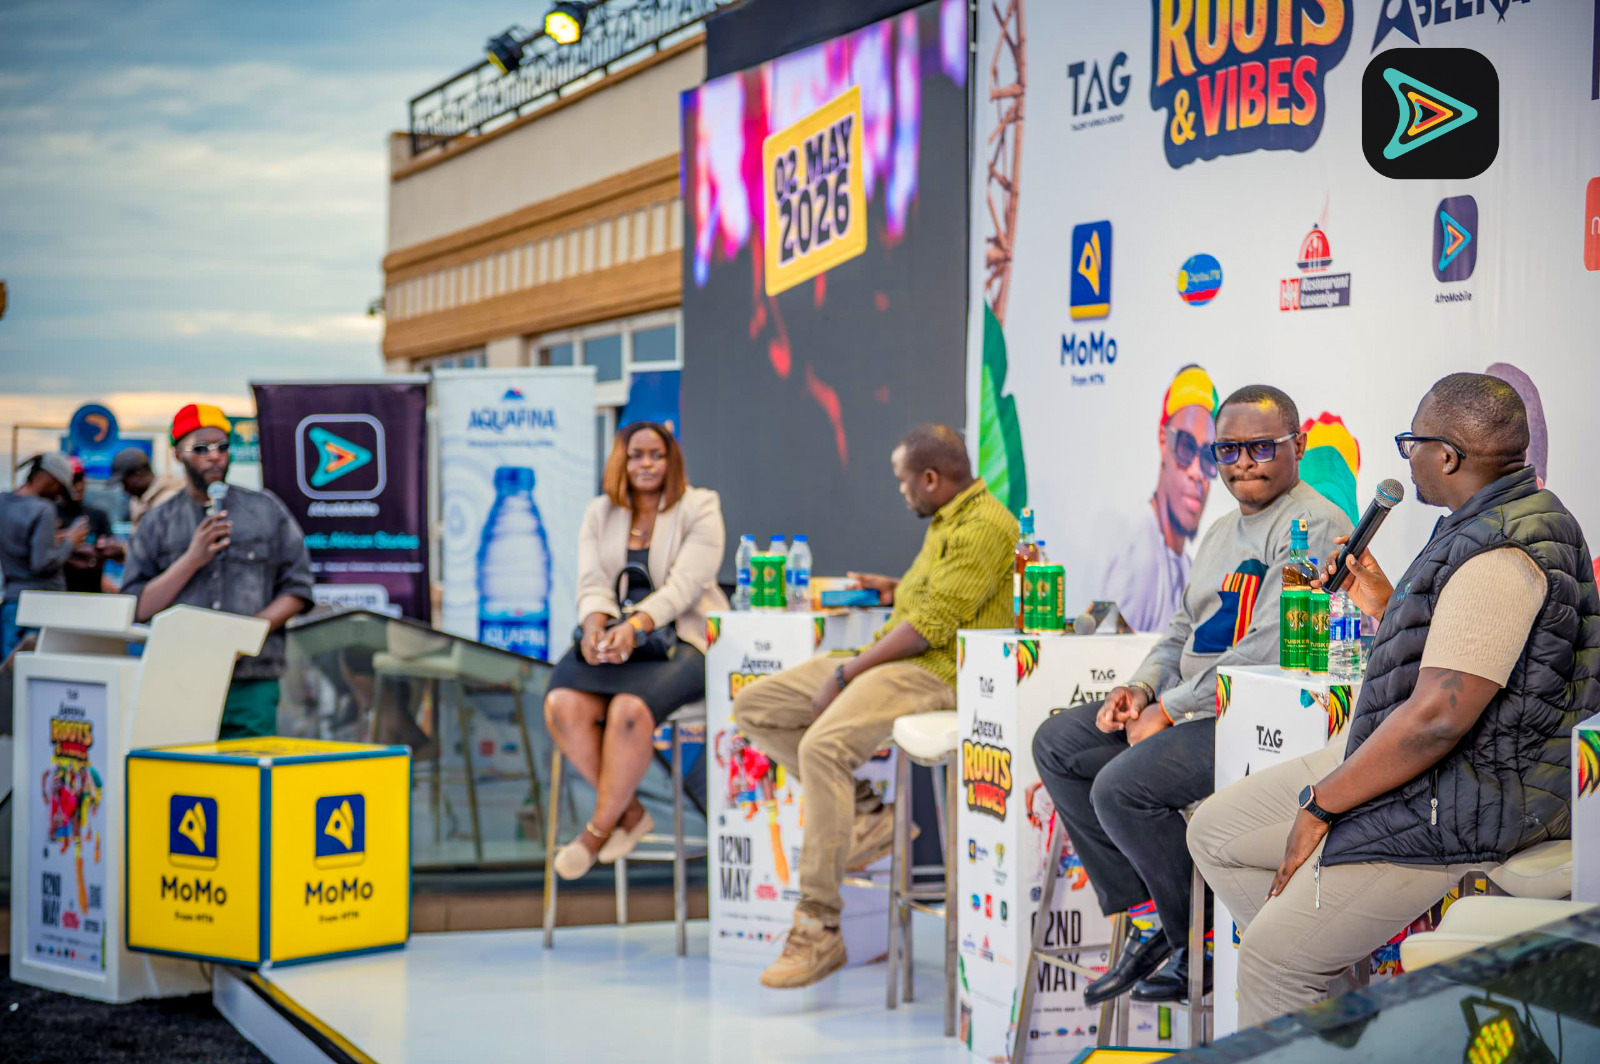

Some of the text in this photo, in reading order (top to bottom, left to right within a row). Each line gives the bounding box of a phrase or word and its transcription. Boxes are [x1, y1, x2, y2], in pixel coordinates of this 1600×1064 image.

[1067, 51, 1131, 116] TAG
[1170, 55, 1318, 145] & VIBES
[775, 115, 854, 200] 02 MAY
[780, 168, 850, 264] 2026
[1060, 331, 1118, 366] MoMo
[467, 408, 558, 434] AQUAFINA
[979, 676, 995, 694] TAG
[1090, 669, 1116, 680] TAG
[1256, 725, 1283, 748] TAG
[963, 741, 1011, 791] ROOTS
[975, 781, 1006, 815] VIBES
[719, 835, 751, 865] 02ND
[161, 875, 227, 905] MoMo
[305, 877, 374, 906] MoMo
[720, 865, 750, 902] MAY
